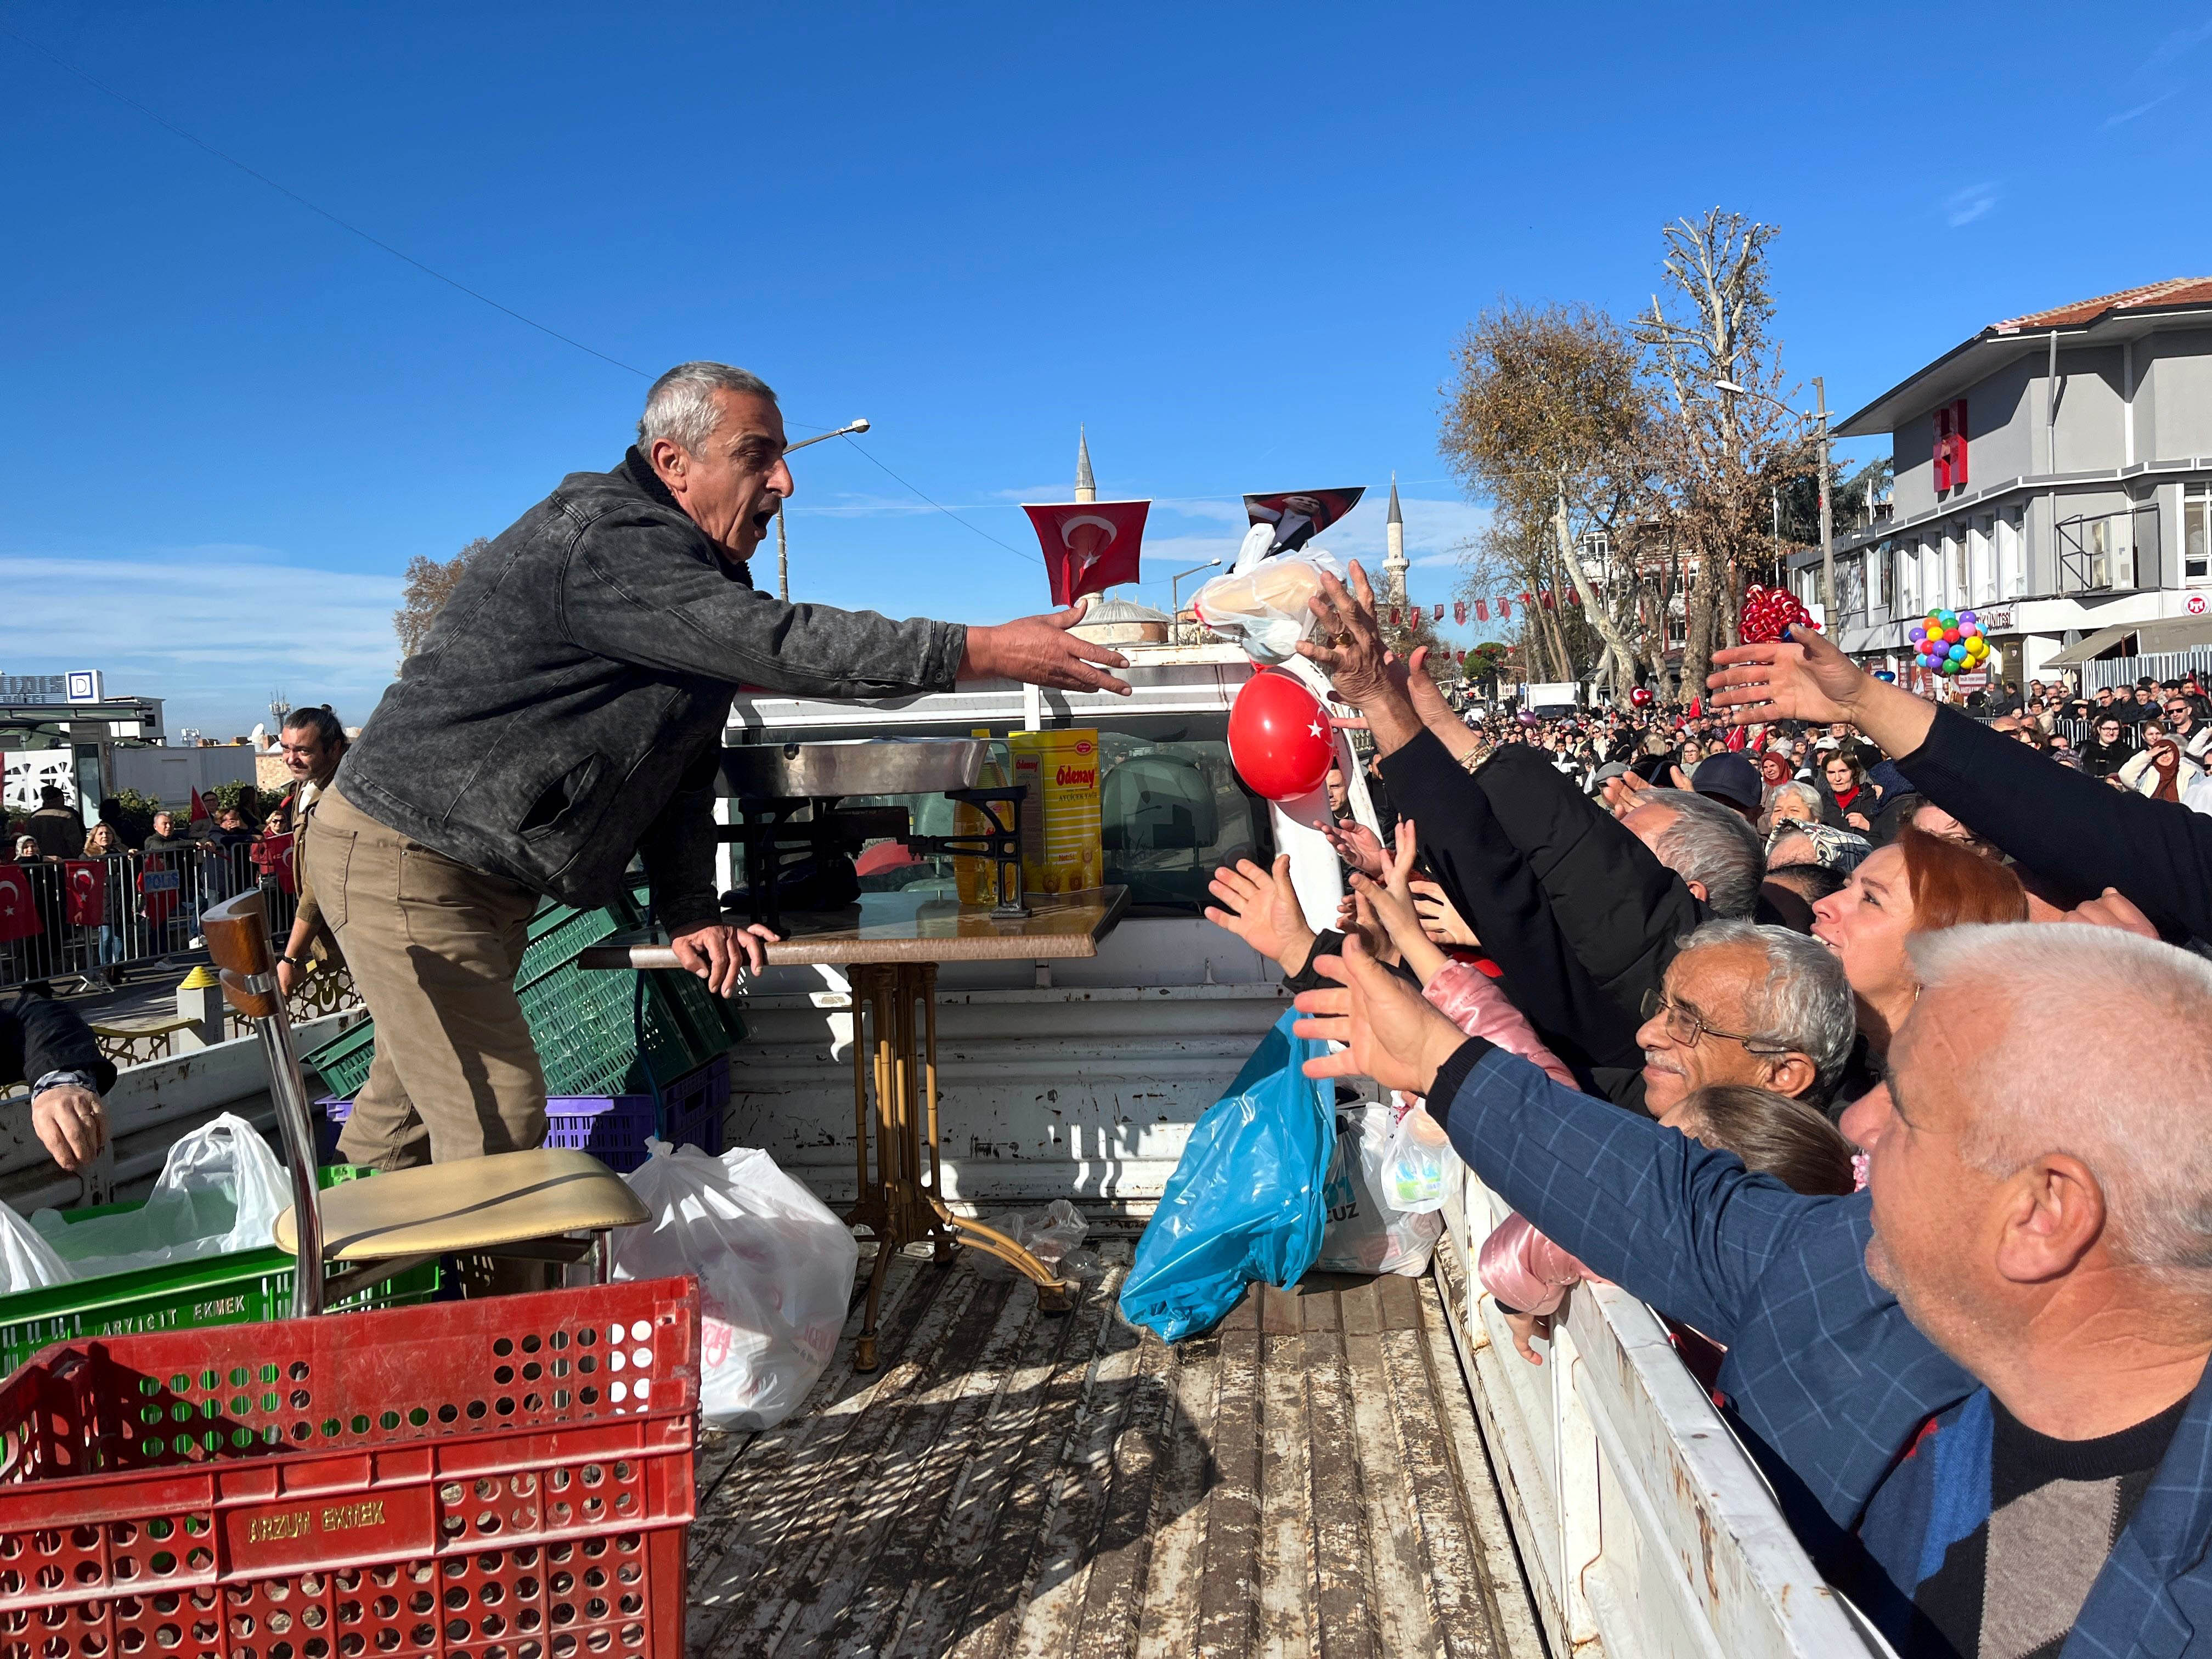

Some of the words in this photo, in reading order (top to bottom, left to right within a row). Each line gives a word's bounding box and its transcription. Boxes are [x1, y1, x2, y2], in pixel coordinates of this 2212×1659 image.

[76, 678, 87, 693] D
[193, 1295, 245, 1322] EKMEK
[320, 1500, 385, 1532] EKMEK
